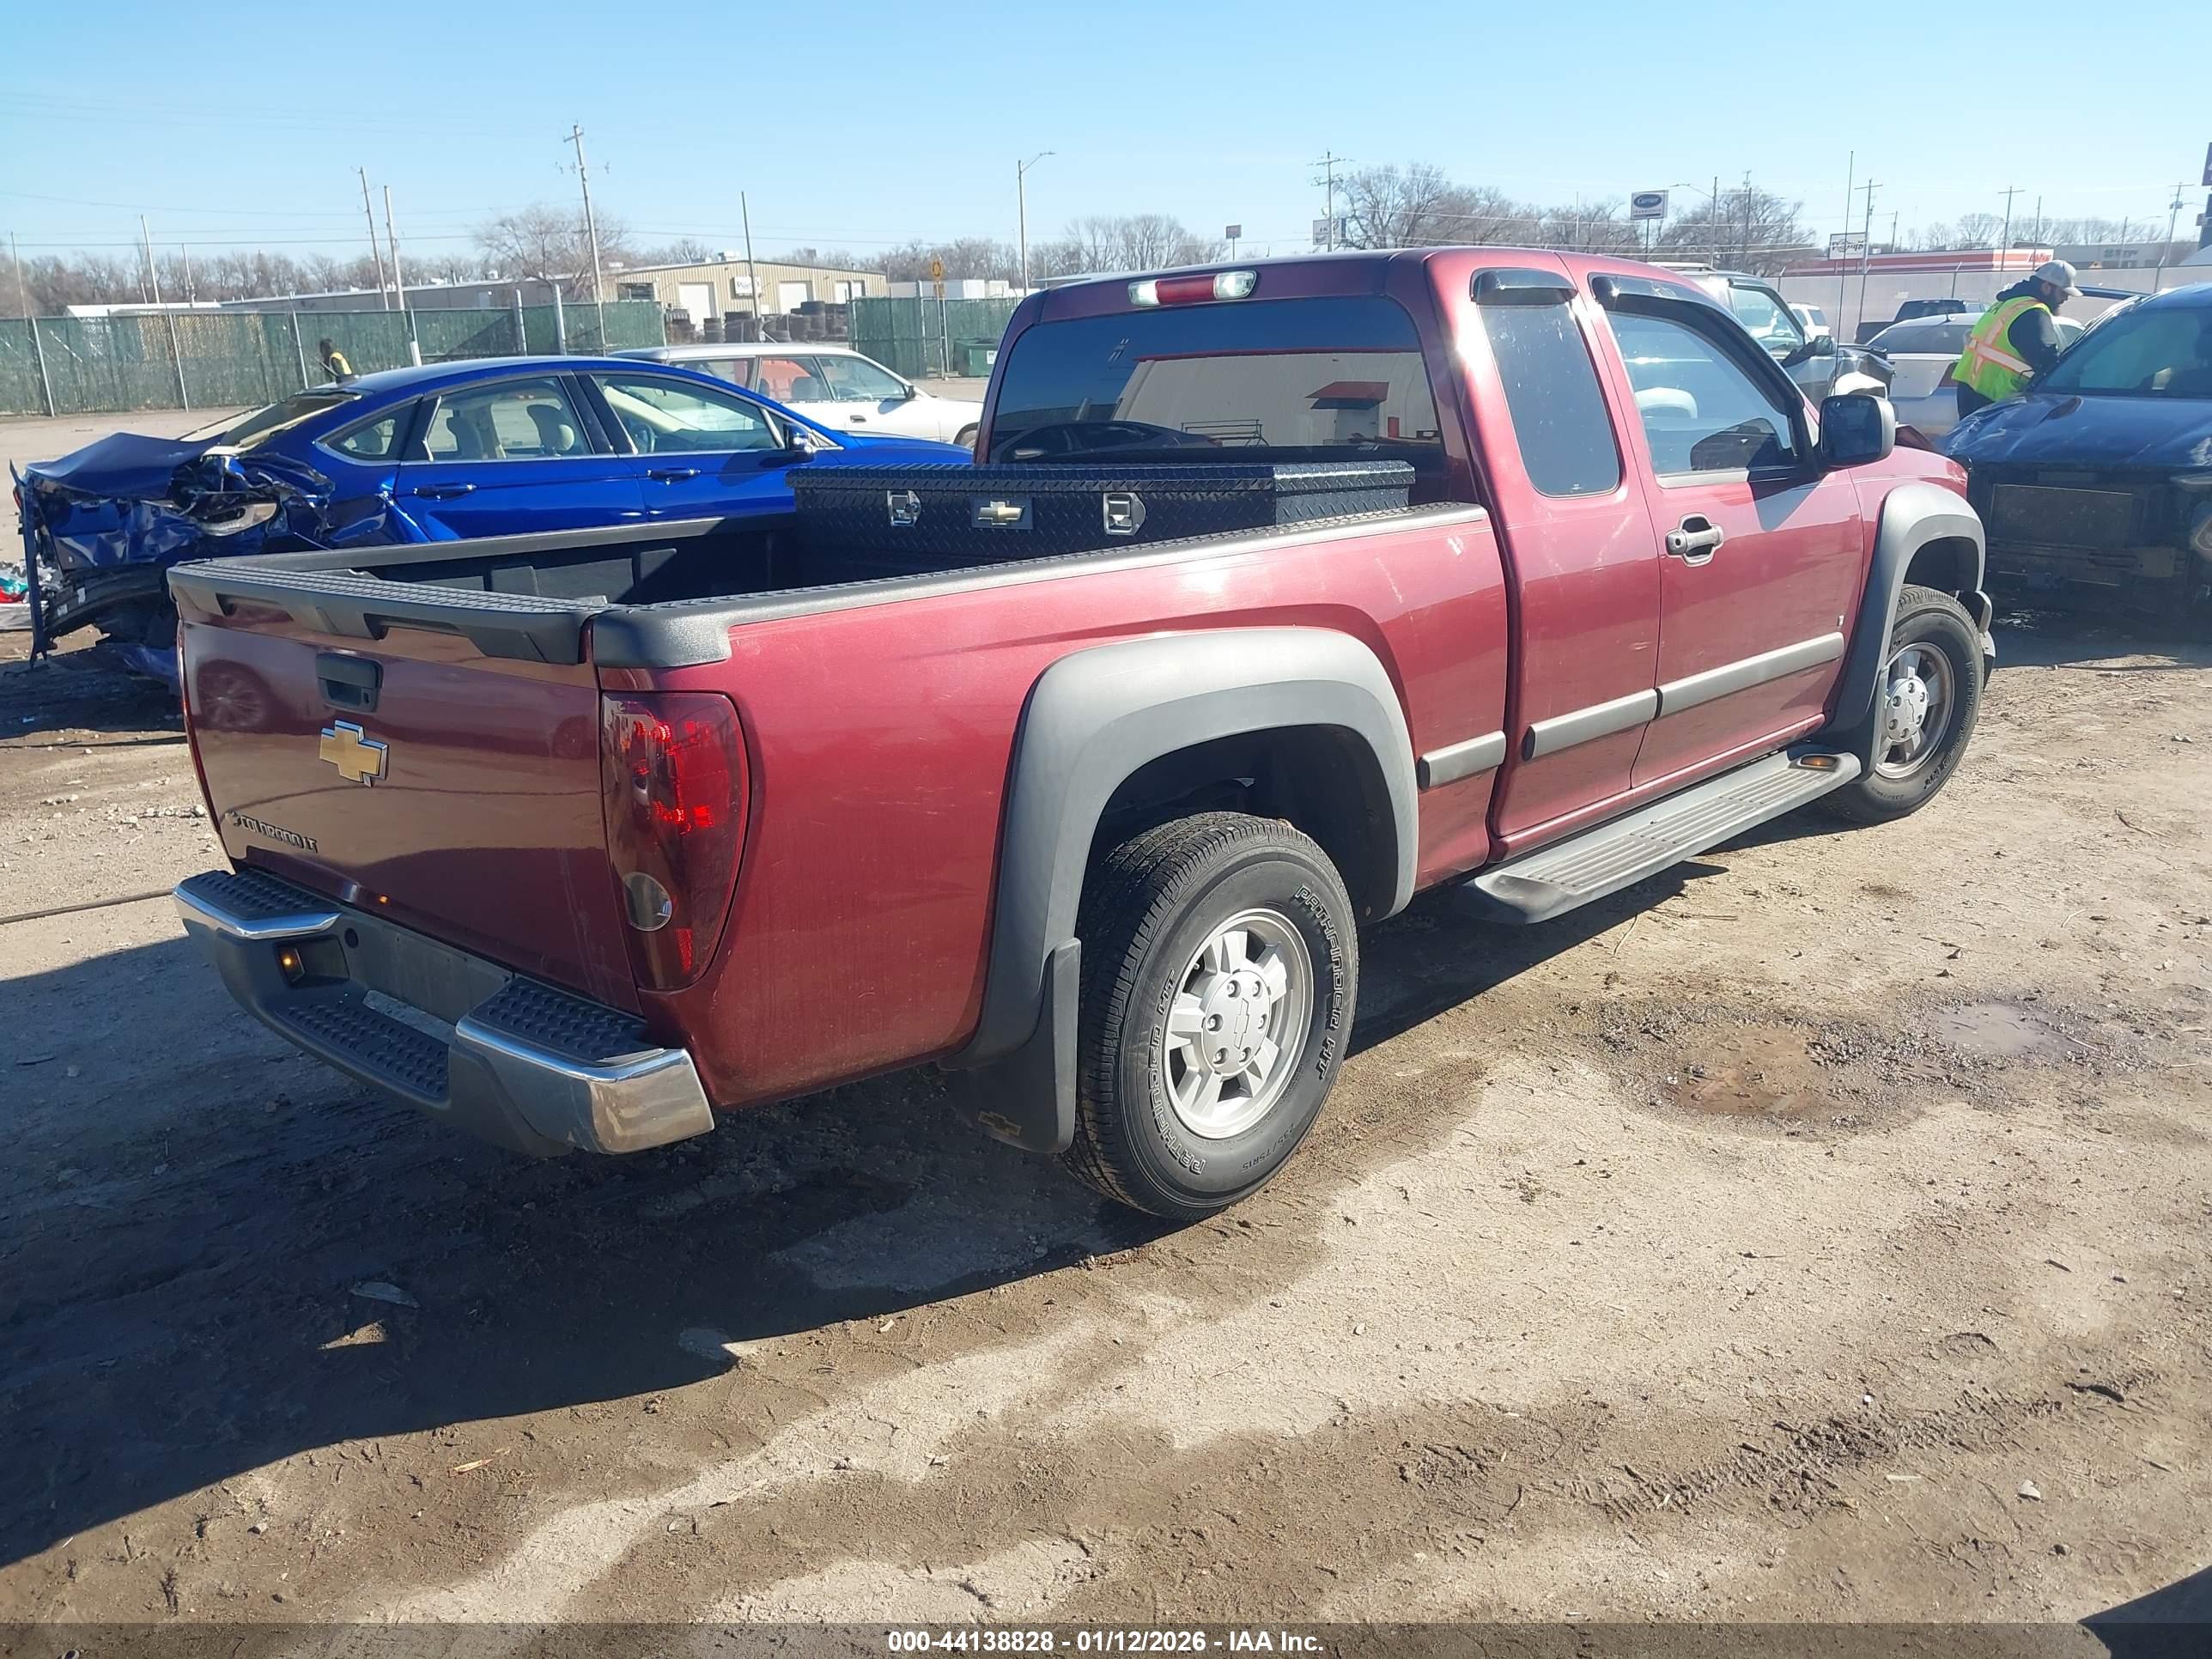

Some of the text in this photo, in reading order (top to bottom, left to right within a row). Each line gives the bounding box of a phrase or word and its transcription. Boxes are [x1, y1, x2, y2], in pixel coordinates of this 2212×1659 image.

[240, 814, 319, 854] COLORADO LT
[1148, 969, 1206, 1175] PATHFINDER HT
[1294, 884, 1344, 1081] PATHFINDER HT
